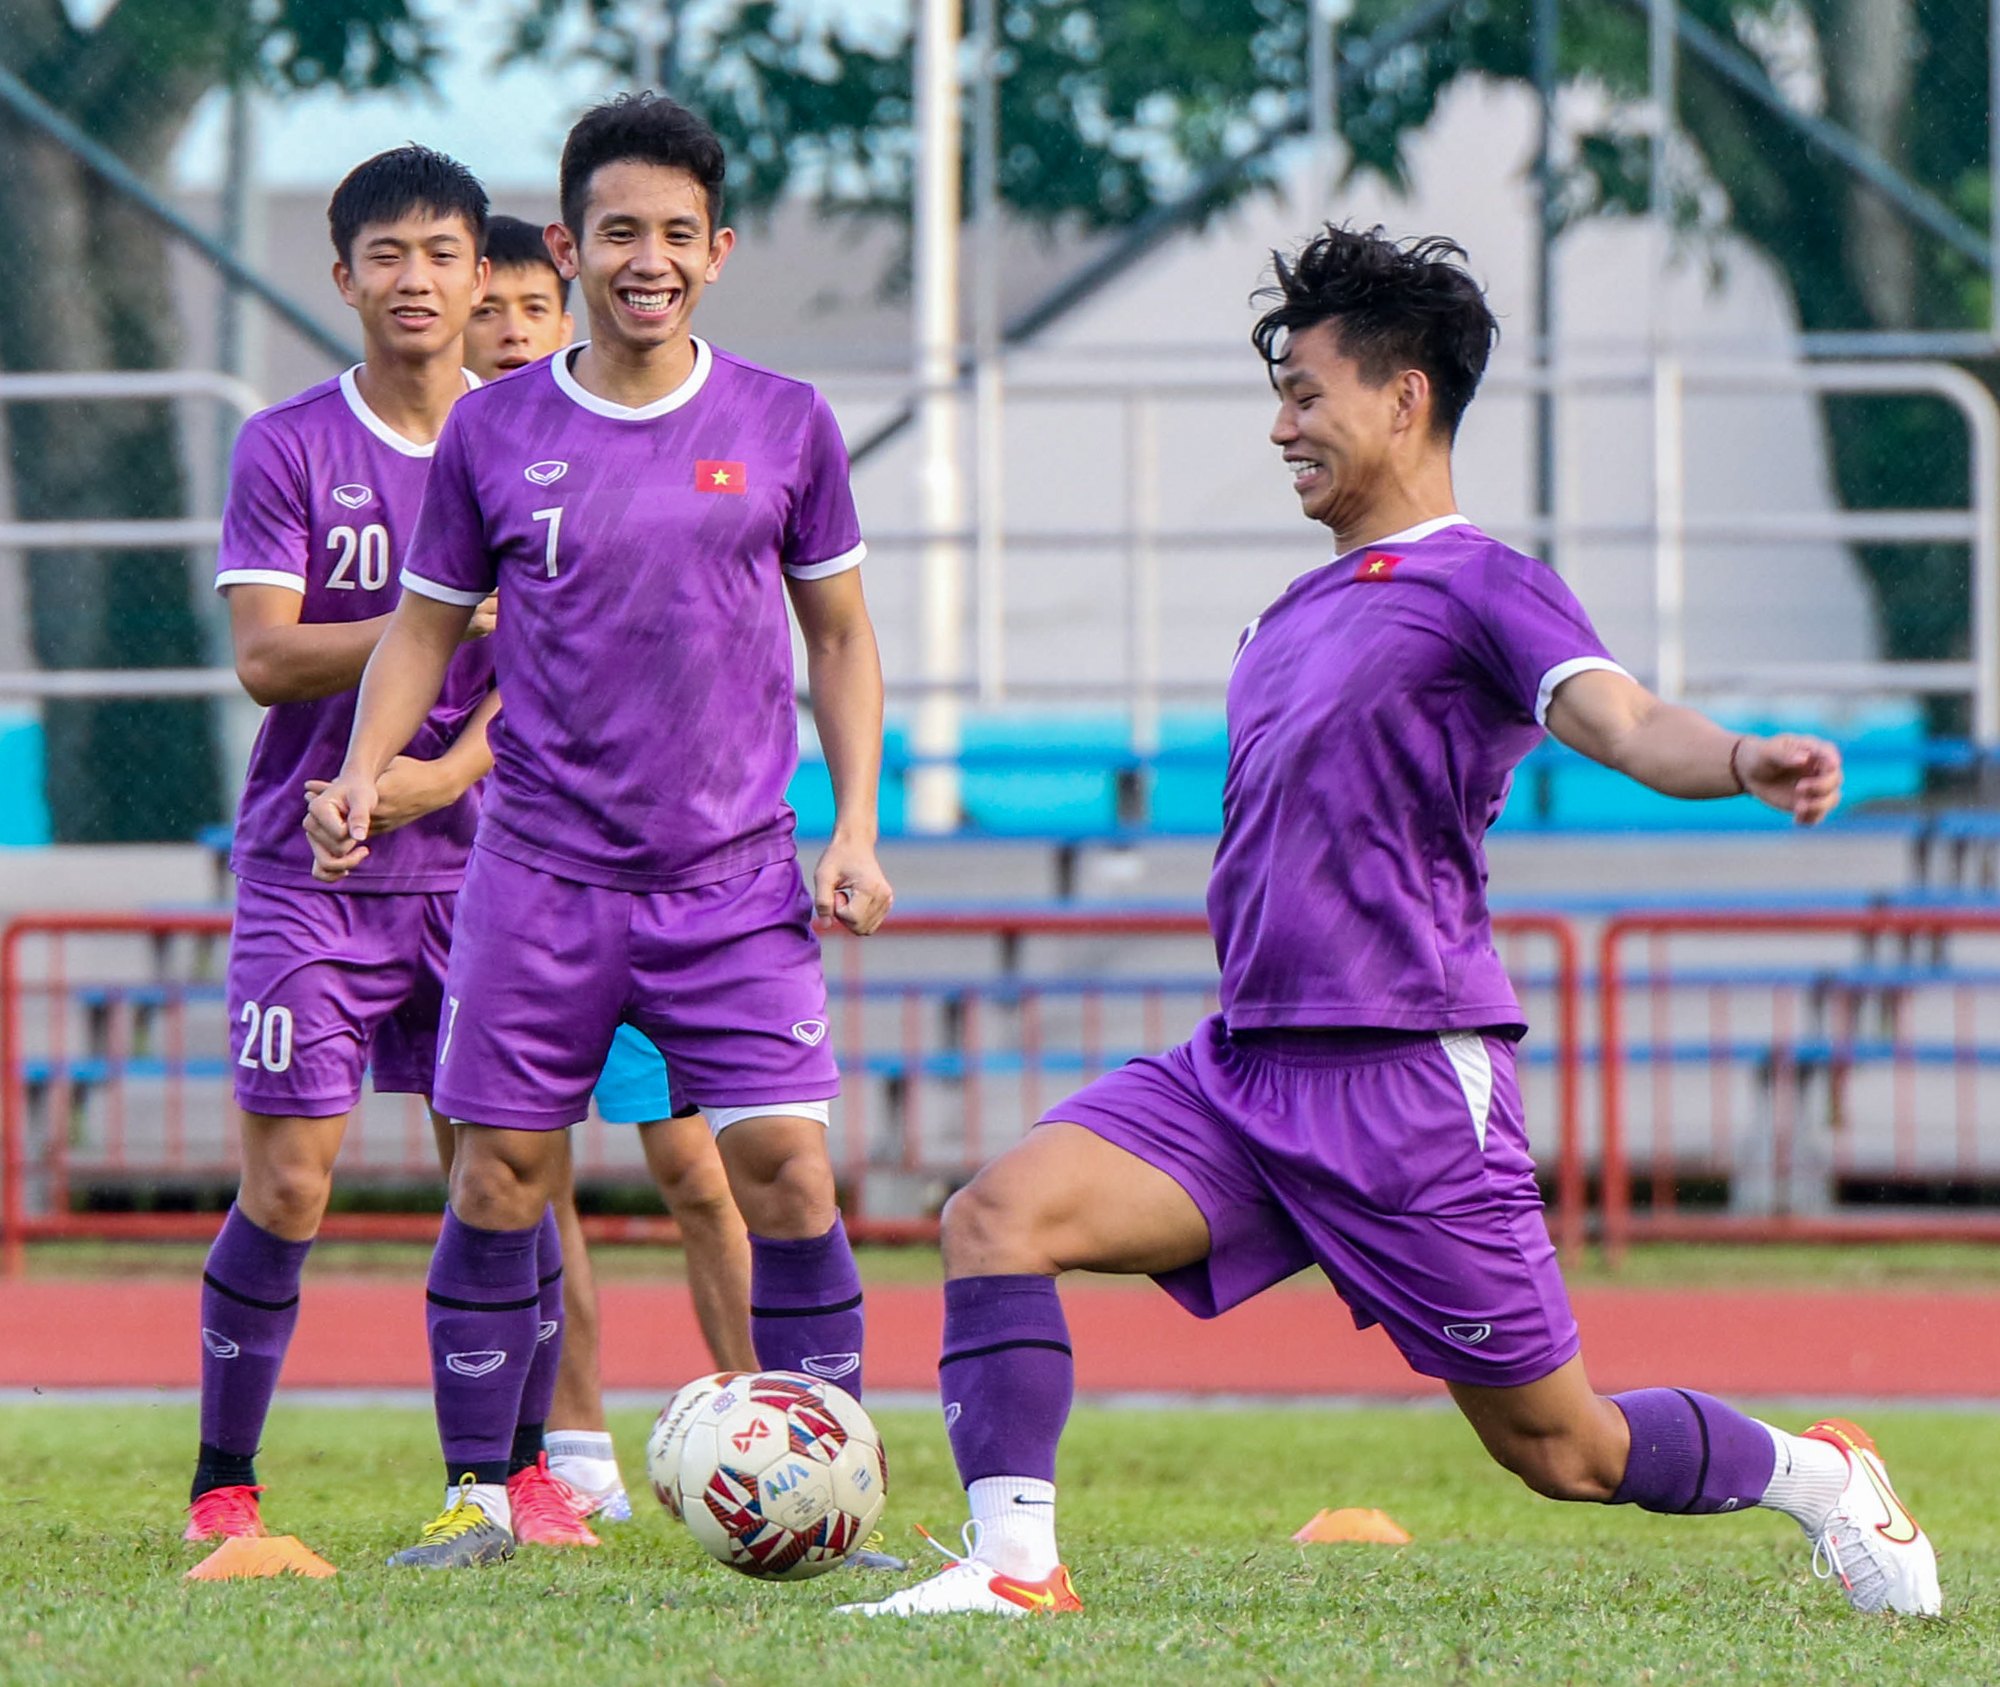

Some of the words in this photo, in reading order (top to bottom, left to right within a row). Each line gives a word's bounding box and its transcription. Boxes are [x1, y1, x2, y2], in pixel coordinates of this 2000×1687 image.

[324, 524, 390, 591] 20
[532, 506, 564, 578] 7
[238, 1000, 293, 1073] 20
[440, 995, 460, 1066] 7
